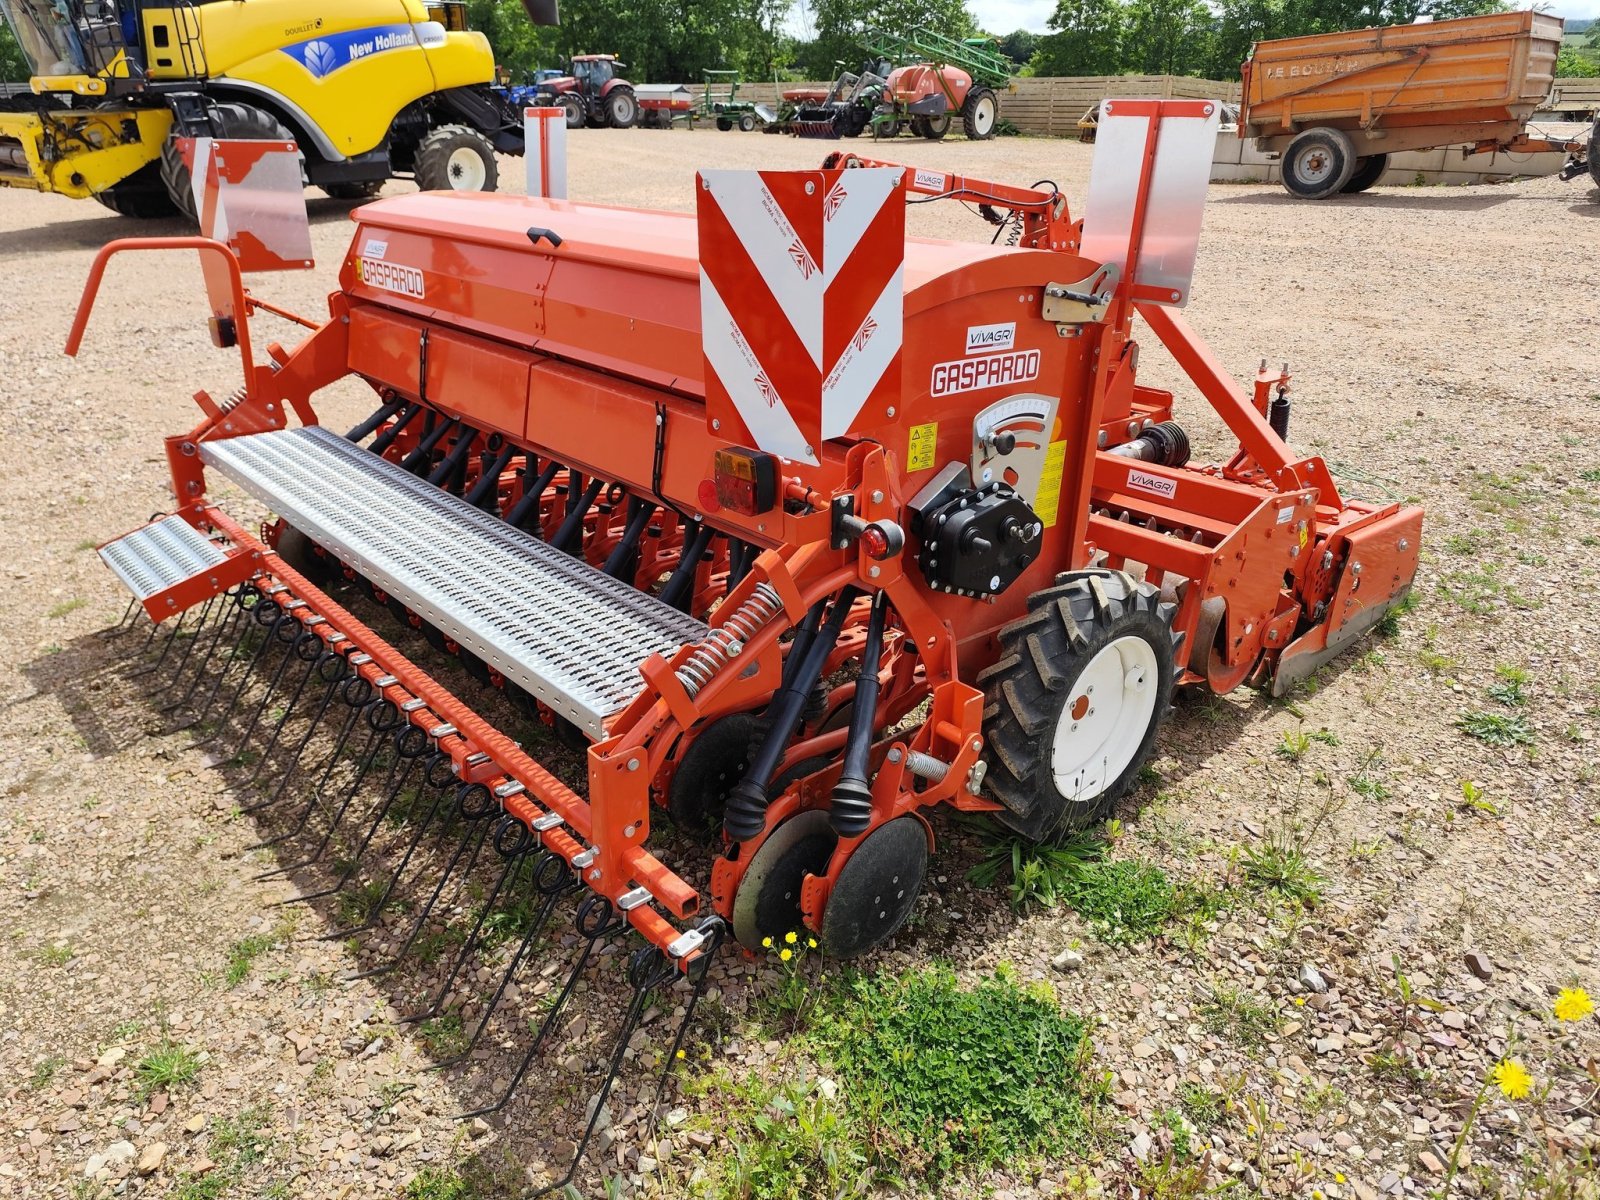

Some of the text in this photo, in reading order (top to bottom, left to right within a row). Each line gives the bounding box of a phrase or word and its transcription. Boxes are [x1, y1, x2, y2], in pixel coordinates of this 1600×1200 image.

[349, 30, 414, 60] New Holland
[363, 260, 423, 297] GASPARDO
[932, 352, 1039, 395] GASPARDO
